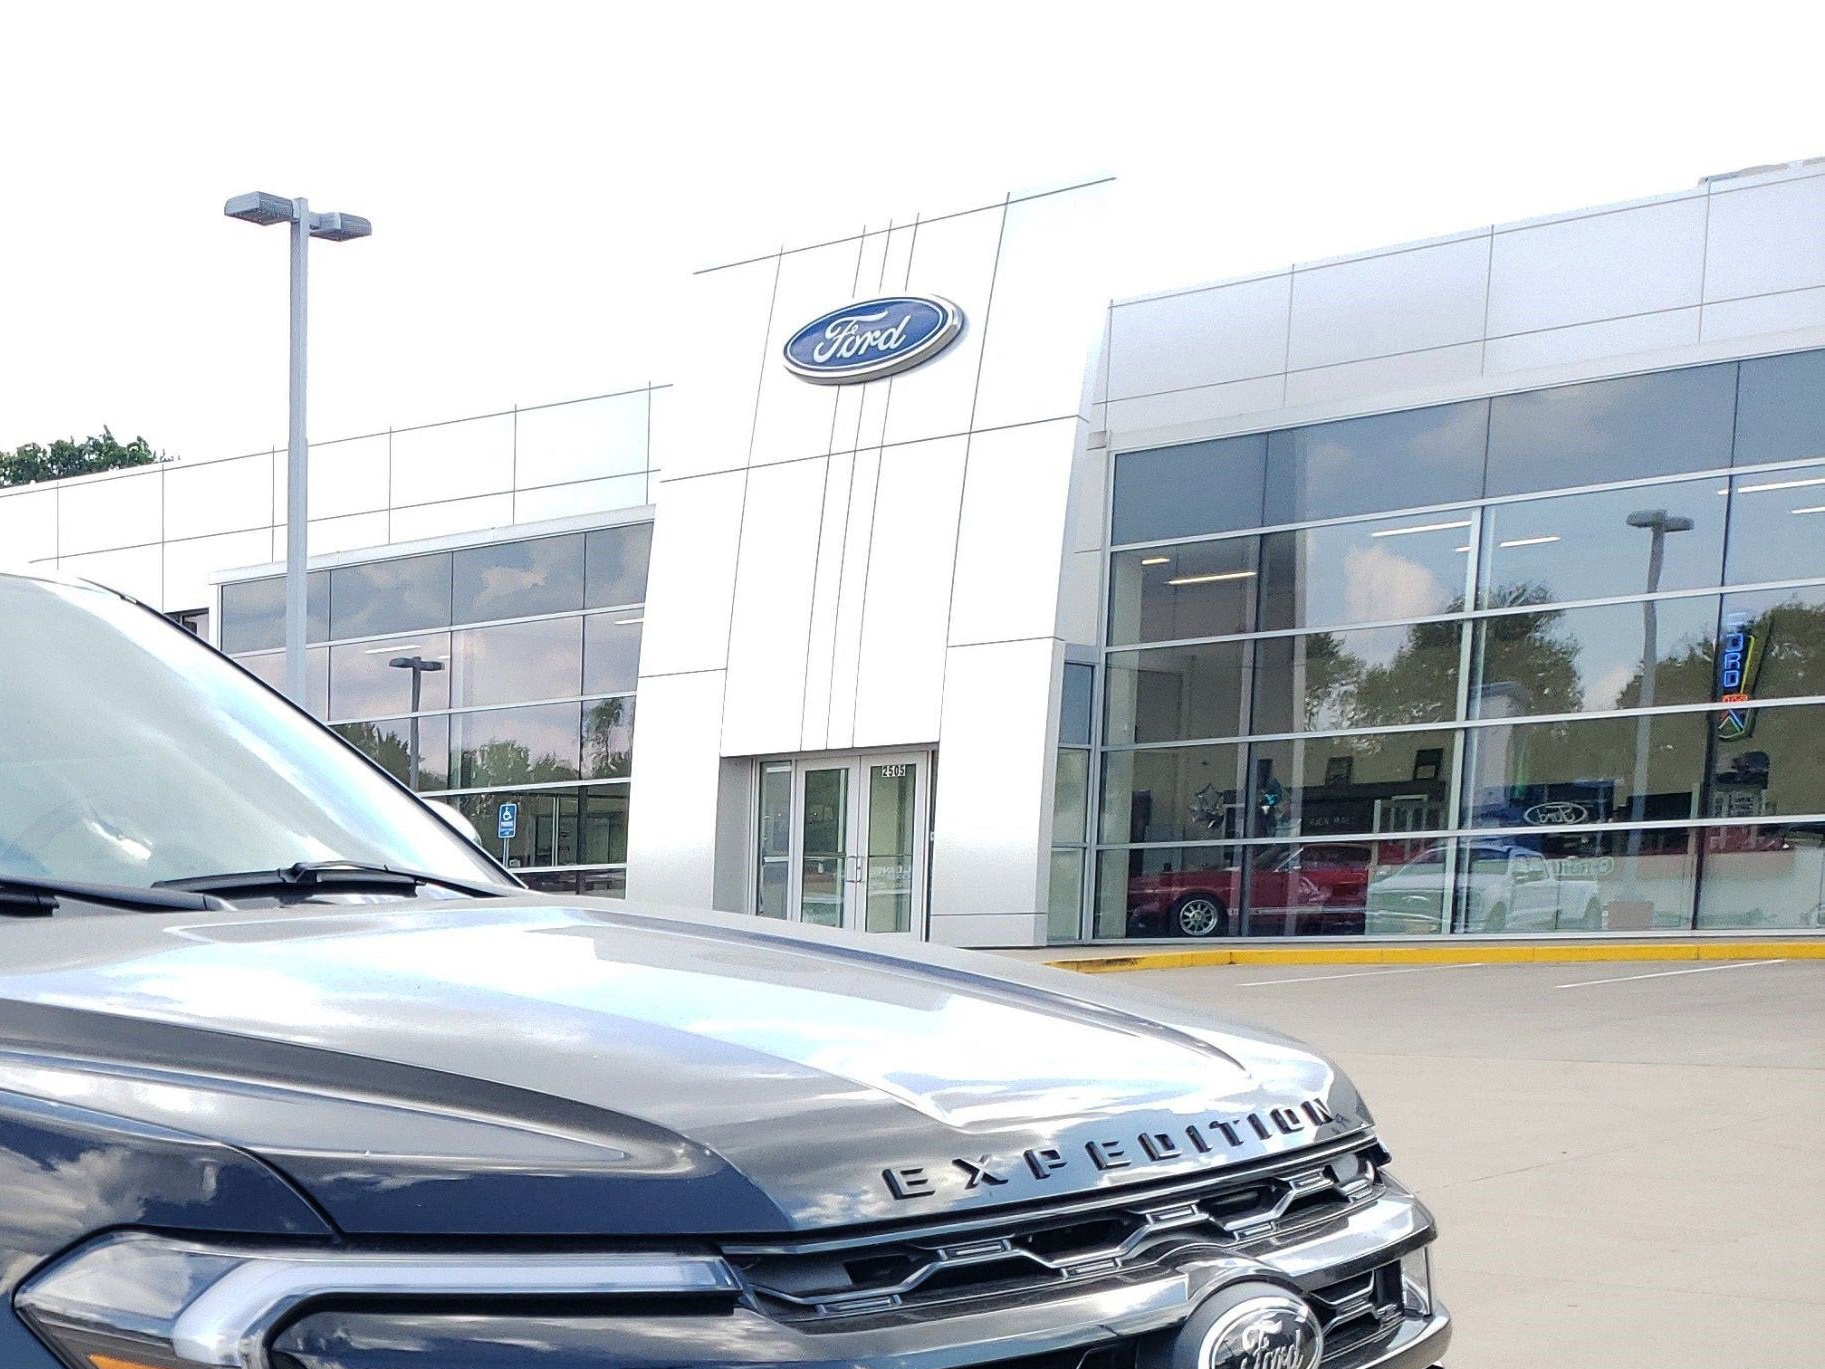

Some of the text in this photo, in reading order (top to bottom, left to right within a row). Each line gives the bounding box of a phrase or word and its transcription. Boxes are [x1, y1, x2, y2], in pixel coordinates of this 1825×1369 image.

[812, 310, 912, 363] Ford
[882, 766, 905, 777] 2505
[881, 1097, 1338, 1200] EXPEDITION
